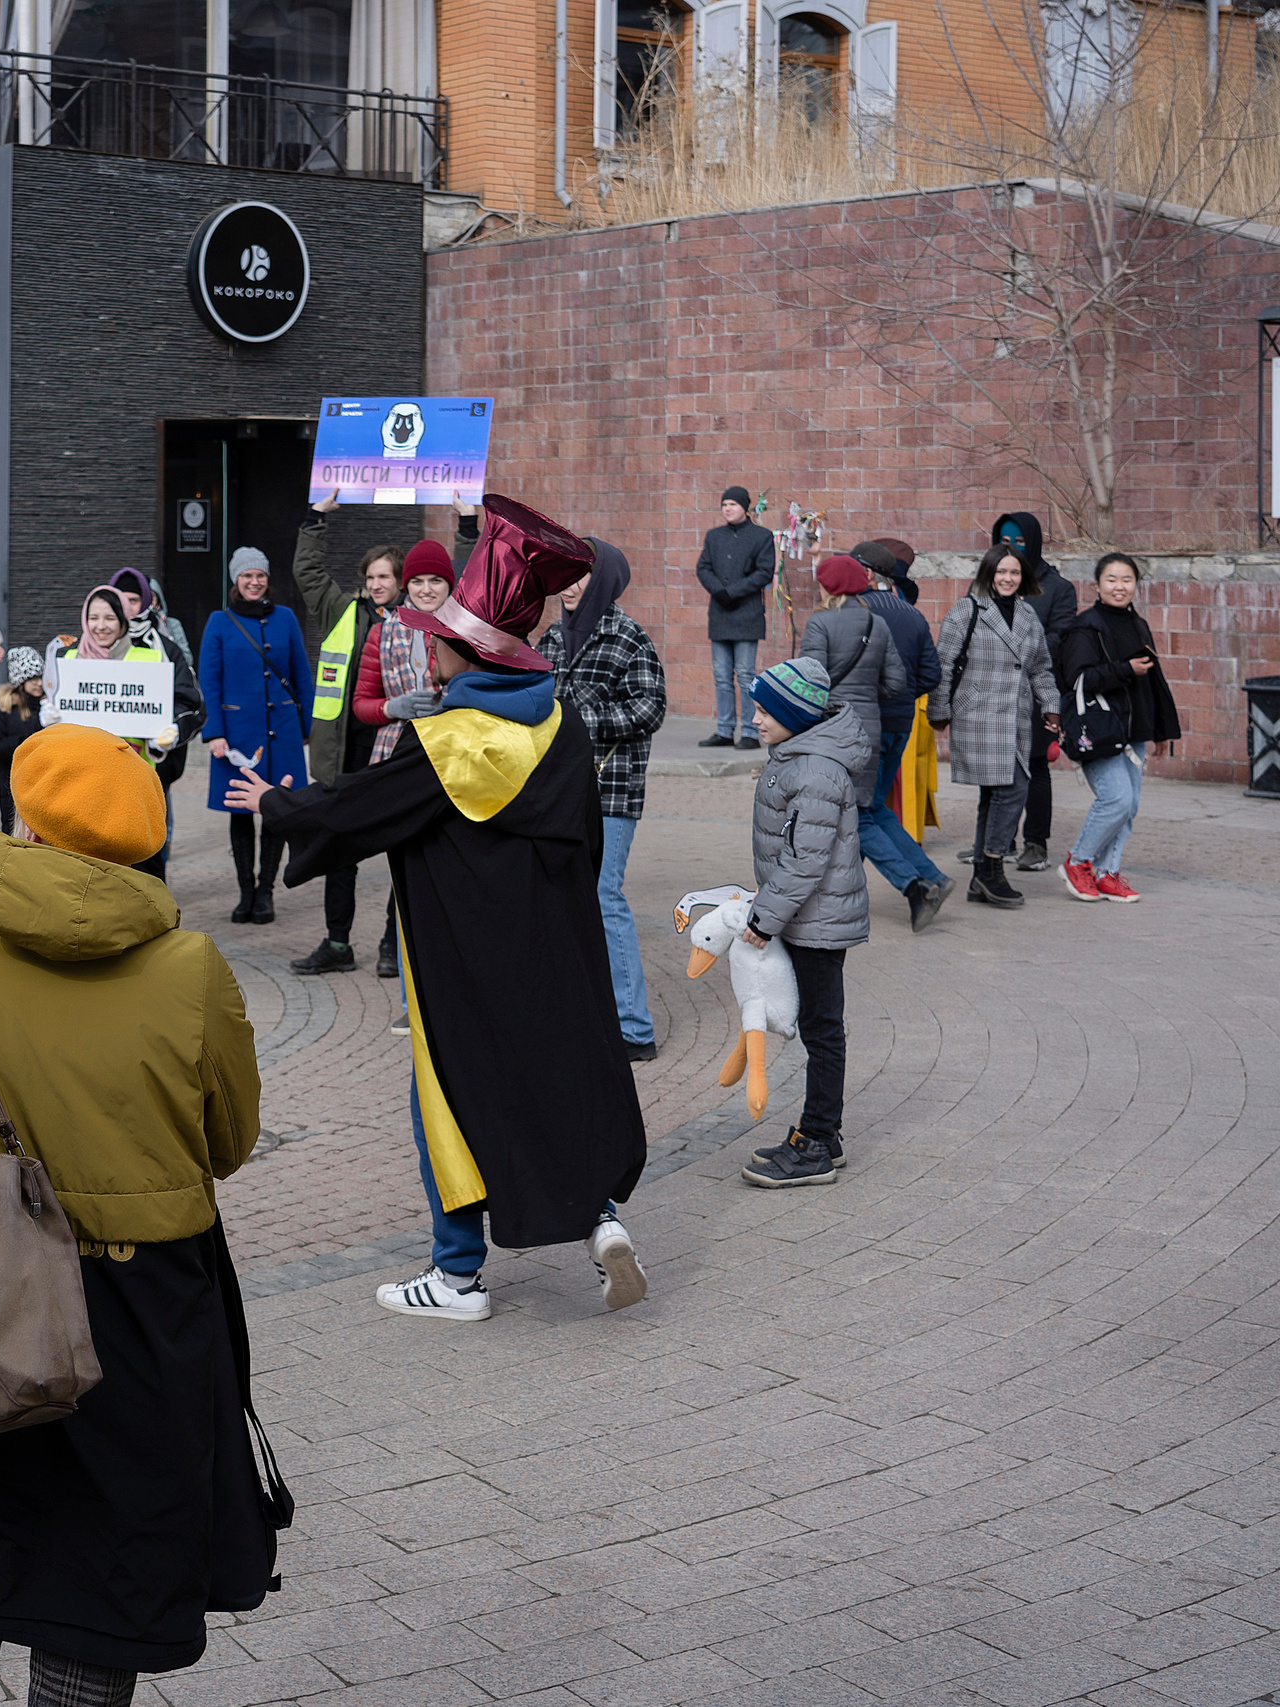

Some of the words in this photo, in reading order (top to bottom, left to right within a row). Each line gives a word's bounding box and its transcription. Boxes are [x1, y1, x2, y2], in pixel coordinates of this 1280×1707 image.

[322, 465, 390, 483] ОТПУСТИ
[405, 463, 473, 484] ГУСЕЙ!!!
[78, 682, 117, 695] МЕСТО
[121, 684, 145, 697] ДЛЯ
[60, 698, 99, 712] ВАШЕЙ
[104, 701, 162, 715] РЕКЛАМЫ
